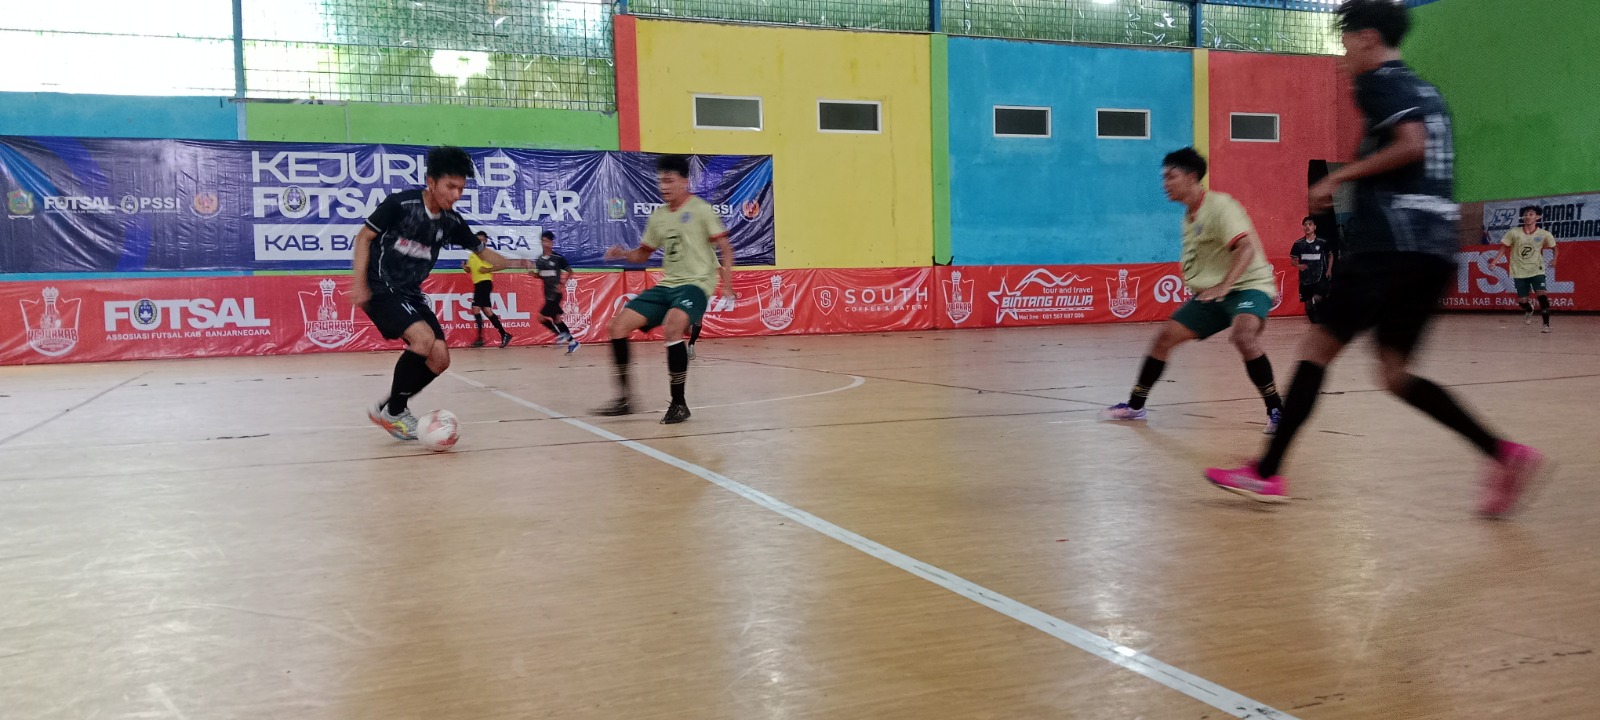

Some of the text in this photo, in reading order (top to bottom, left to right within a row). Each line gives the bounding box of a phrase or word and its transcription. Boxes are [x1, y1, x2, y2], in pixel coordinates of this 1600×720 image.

[43, 196, 116, 210] FUTSAL
[140, 197, 181, 209] PSSI
[264, 234, 324, 252] KAB.
[845, 286, 928, 304] SOUTH
[1059, 286, 1072, 294] and
[1073, 286, 1093, 294] travel
[893, 304, 929, 312] EATERY
[1001, 295, 1094, 308] BINTANG MULIA
[104, 297, 271, 332] FUTSAL
[106, 332, 150, 341] ASSOSIASI
[151, 331, 183, 339] FUTSAL
[205, 329, 271, 337] BANJARNEGARA
